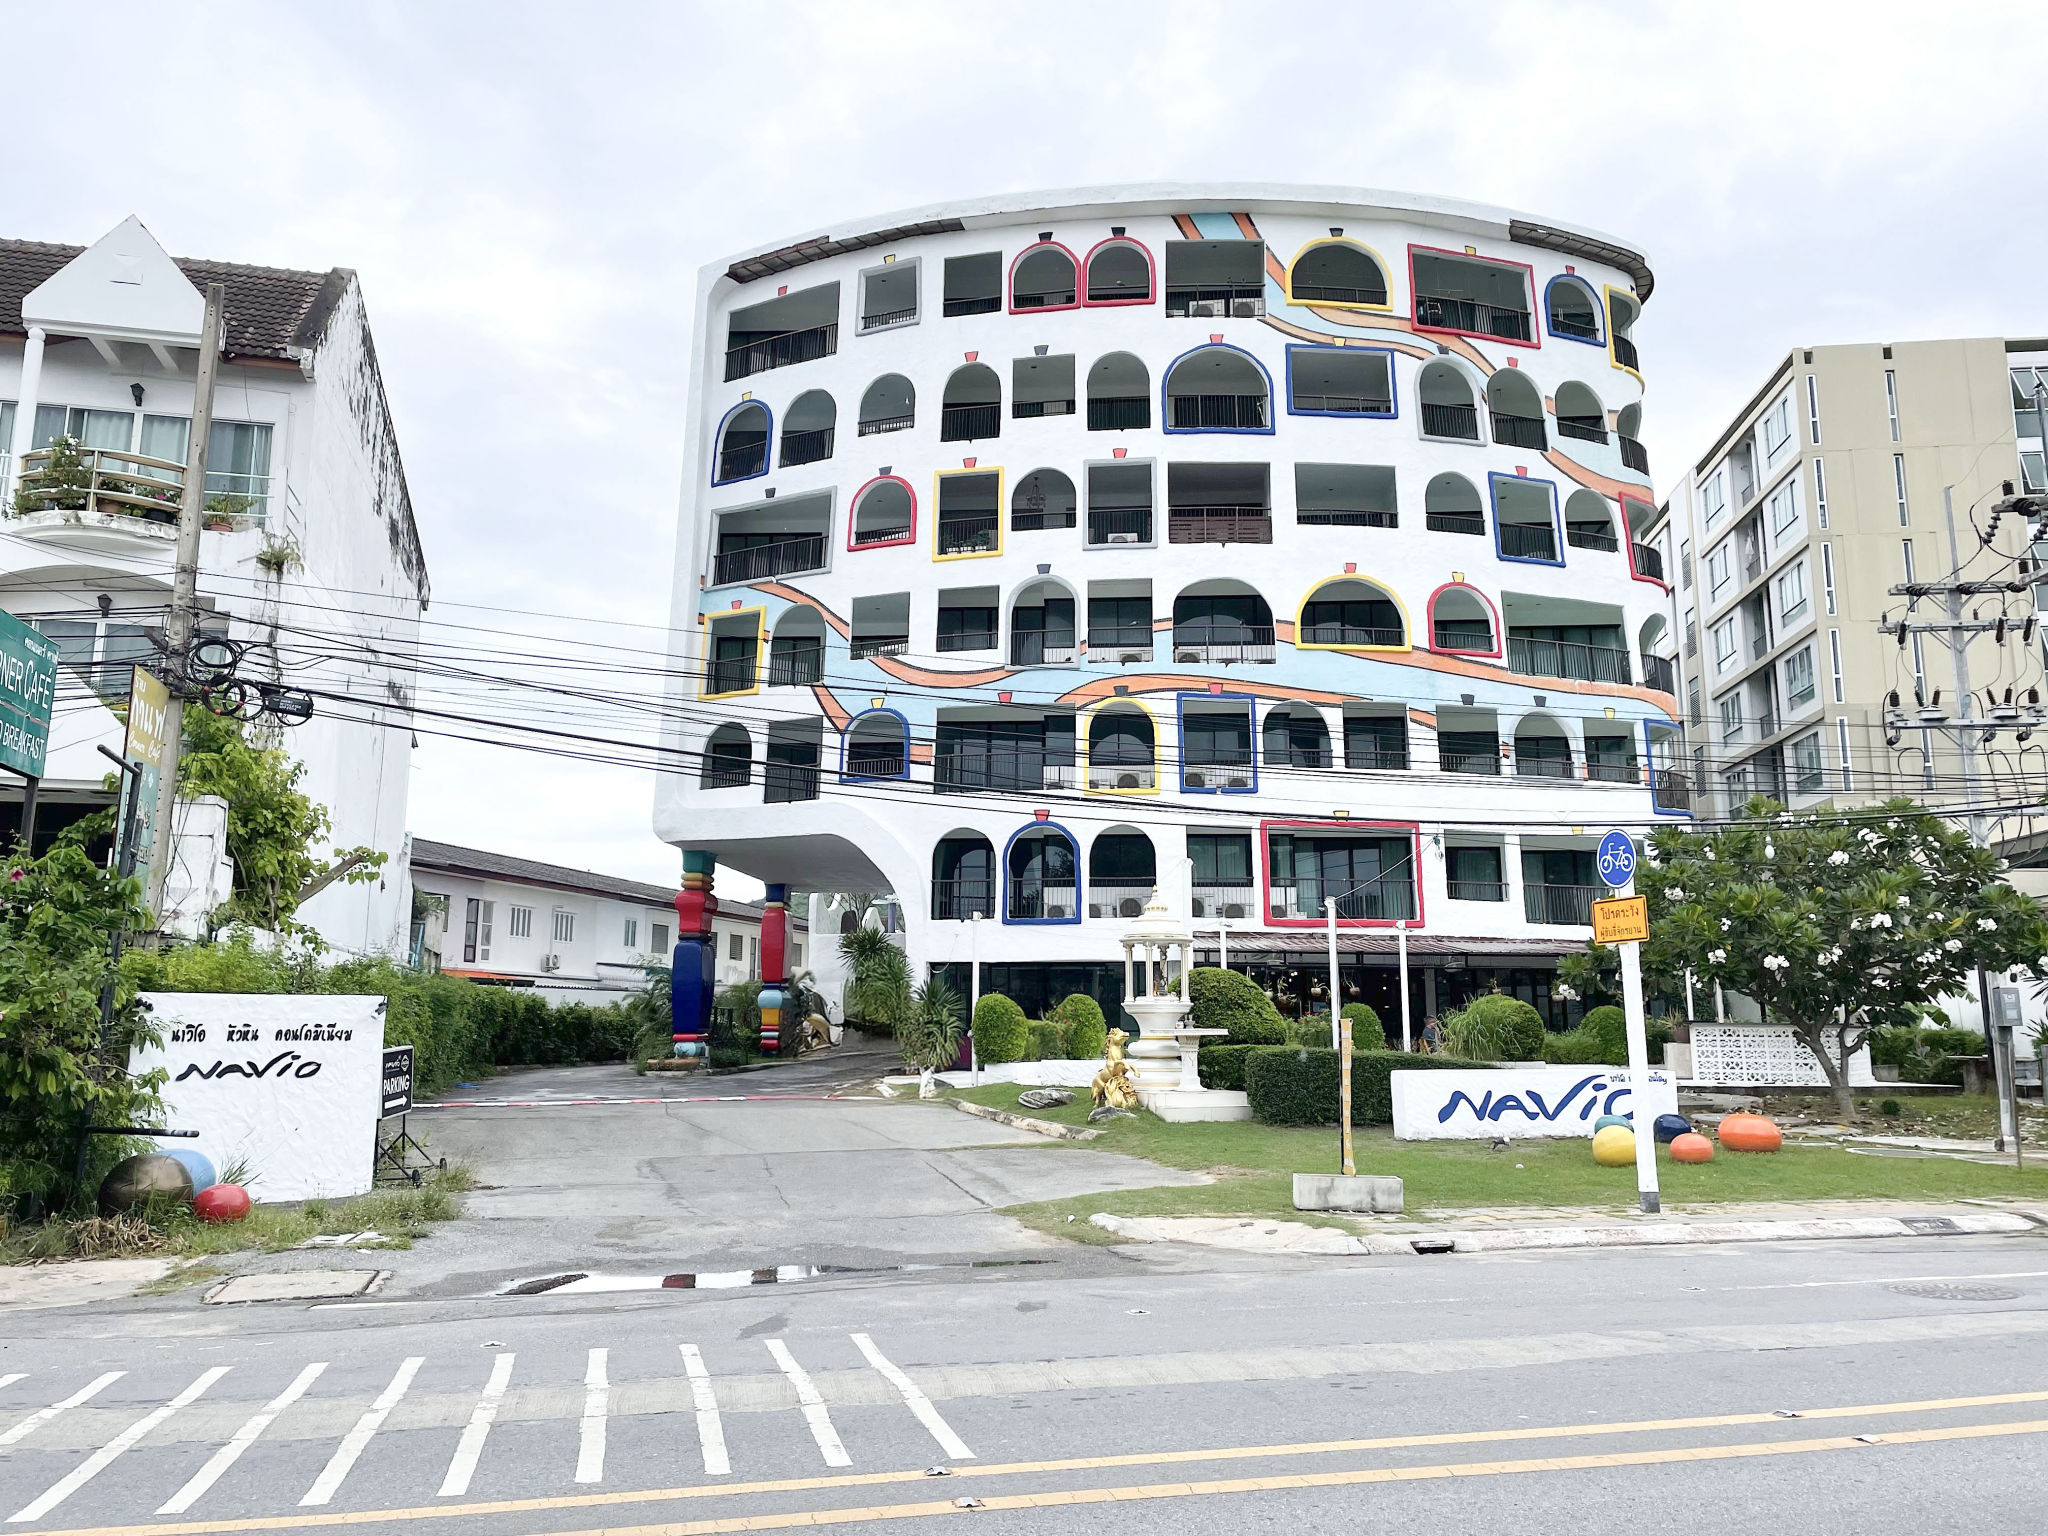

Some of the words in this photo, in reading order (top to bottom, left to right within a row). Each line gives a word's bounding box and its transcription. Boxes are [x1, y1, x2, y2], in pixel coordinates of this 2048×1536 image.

[3, 721, 45, 761] BREAKFAST
[226, 1023, 260, 1043] หัวหิน
[275, 1022, 353, 1042] คอนโดมิเนียม
[383, 1074, 410, 1096] PARKING
